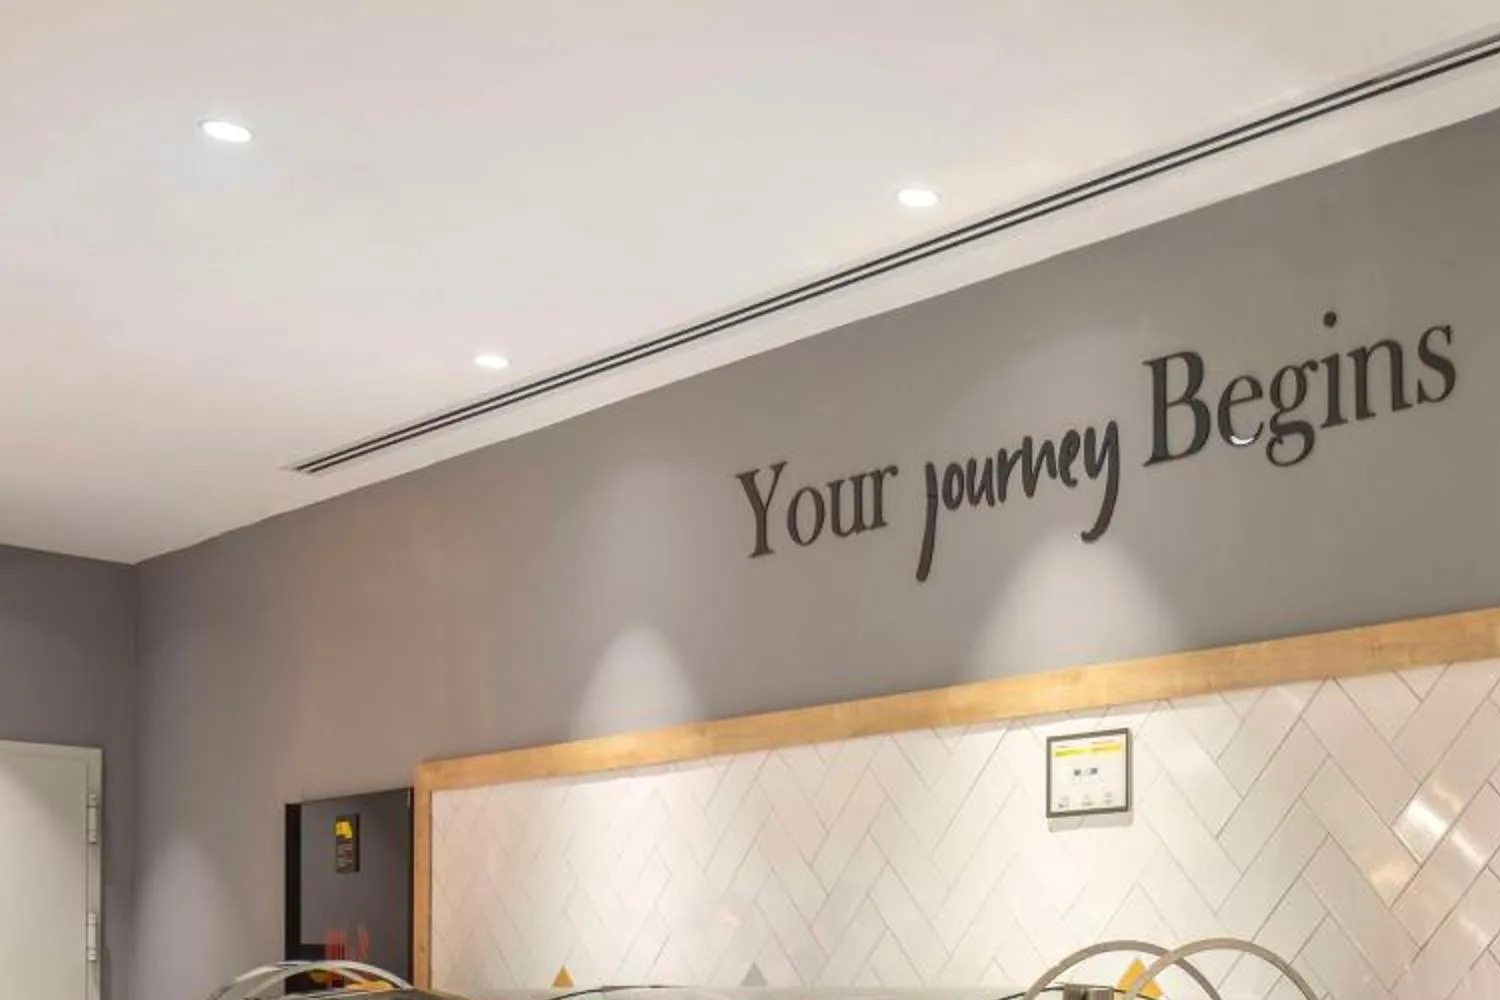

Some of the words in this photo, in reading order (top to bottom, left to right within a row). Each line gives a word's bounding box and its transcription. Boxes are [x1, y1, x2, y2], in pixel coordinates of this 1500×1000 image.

[735, 461, 899, 558] Your
[915, 421, 1120, 583] journey
[1143, 310, 1457, 468] Begins
